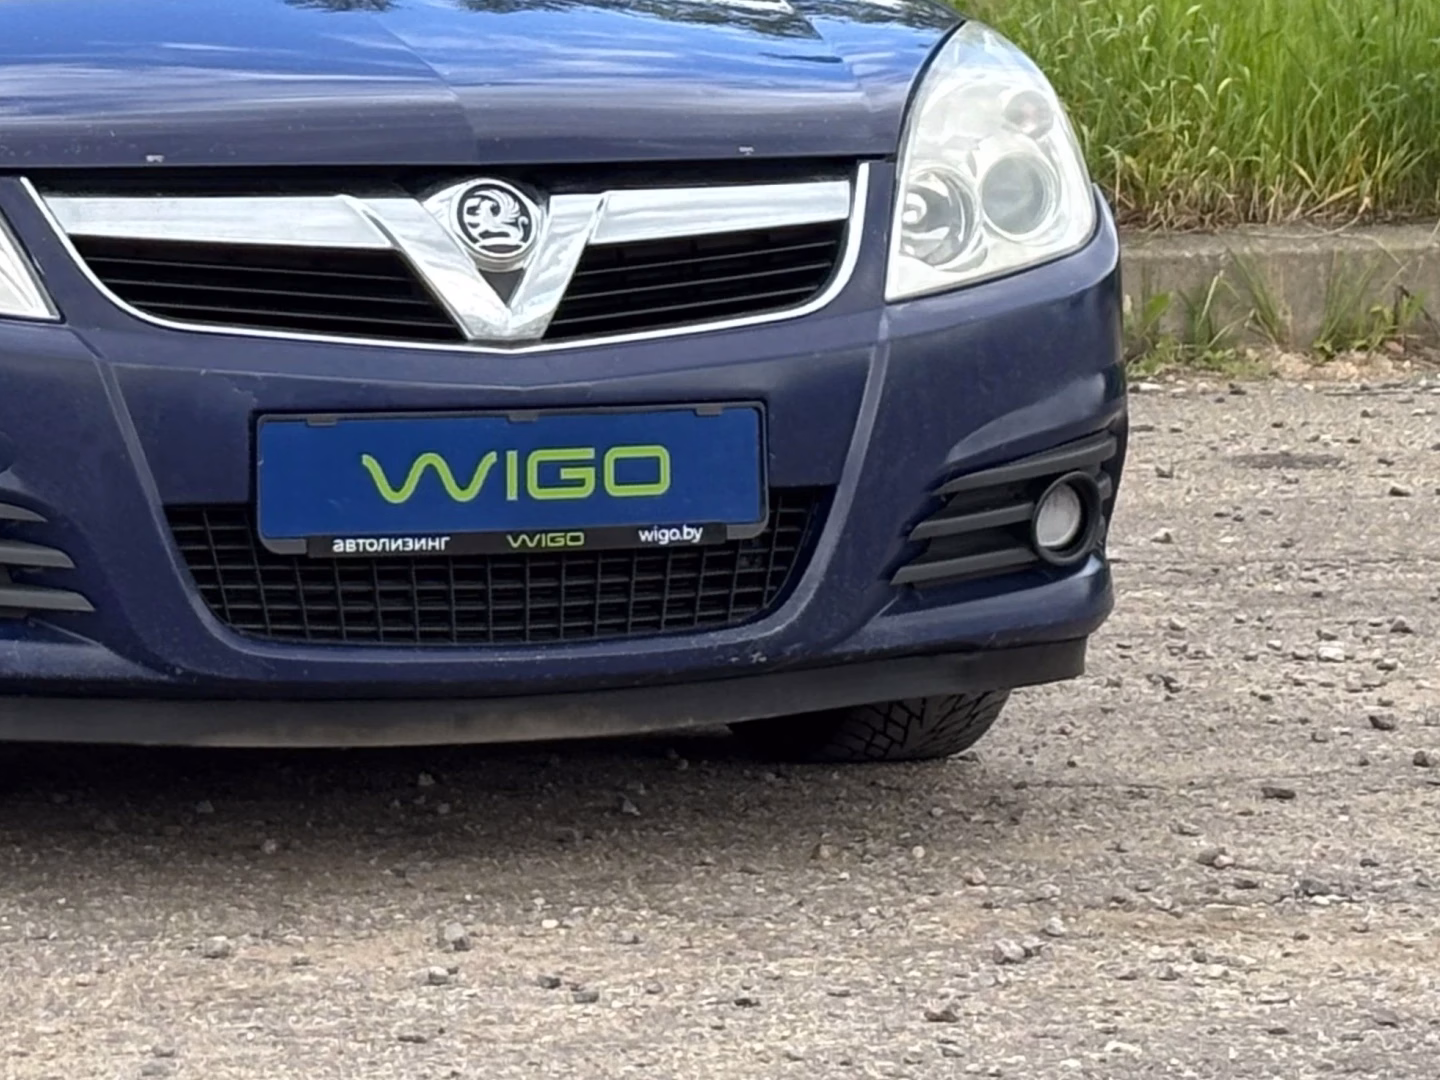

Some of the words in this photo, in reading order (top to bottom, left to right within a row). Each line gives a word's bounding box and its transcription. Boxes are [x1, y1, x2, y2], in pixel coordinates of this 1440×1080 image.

[362, 445, 670, 504] WIGO
[332, 536, 451, 553] автолизинг
[506, 532, 585, 548] WIGO
[638, 525, 703, 545] wigo.by
